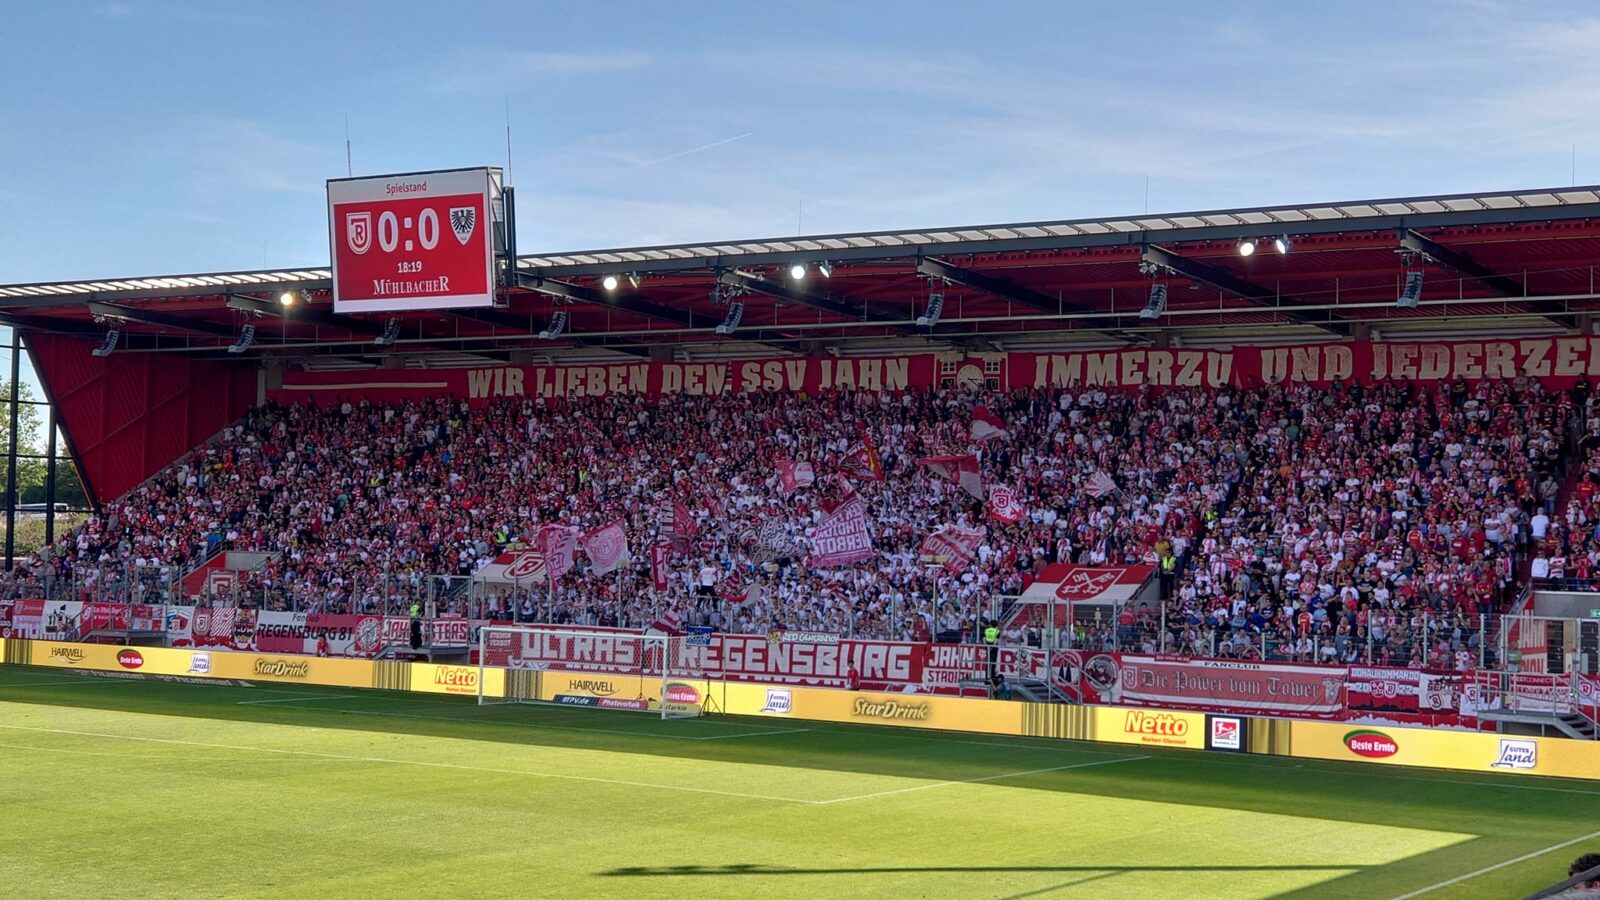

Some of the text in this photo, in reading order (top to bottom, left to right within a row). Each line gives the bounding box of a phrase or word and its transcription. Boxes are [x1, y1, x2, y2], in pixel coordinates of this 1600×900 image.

[386, 181, 428, 196] Spielstand
[377, 207, 440, 253] 0:0
[397, 260, 423, 273] 18:19
[372, 275, 450, 295] MÜHLBACHER
[467, 368, 525, 398] WIR
[536, 364, 649, 398] LIEBEN
[661, 364, 726, 395] DEN
[741, 359, 807, 392] SSV
[818, 357, 909, 391] JAHN
[1034, 350, 1234, 389] IMMERZU
[1260, 346, 1352, 383] UND
[292, 613, 320, 623] Fanclub
[257, 622, 337, 641] REGENSBURG
[338, 626, 353, 641] 81
[51, 647, 84, 659] HAIRWELL
[521, 629, 634, 663] ULTRAS
[679, 635, 912, 680] REGENSBURG
[929, 645, 973, 668] JAHN
[253, 658, 309, 676] StarDrink
[1204, 660, 1261, 670] FANCLUB
[434, 665, 478, 687] Netto
[569, 679, 615, 692] HAIRWELL
[1142, 670, 1168, 688] Die
[1175, 671, 1224, 694] Power
[1229, 678, 1260, 695] vom
[1267, 675, 1319, 698] Tower
[852, 697, 928, 721] StarDrink
[1124, 710, 1189, 737] Netto
[1351, 738, 1396, 753] Beste Ernte
[1498, 744, 1536, 764] Land
